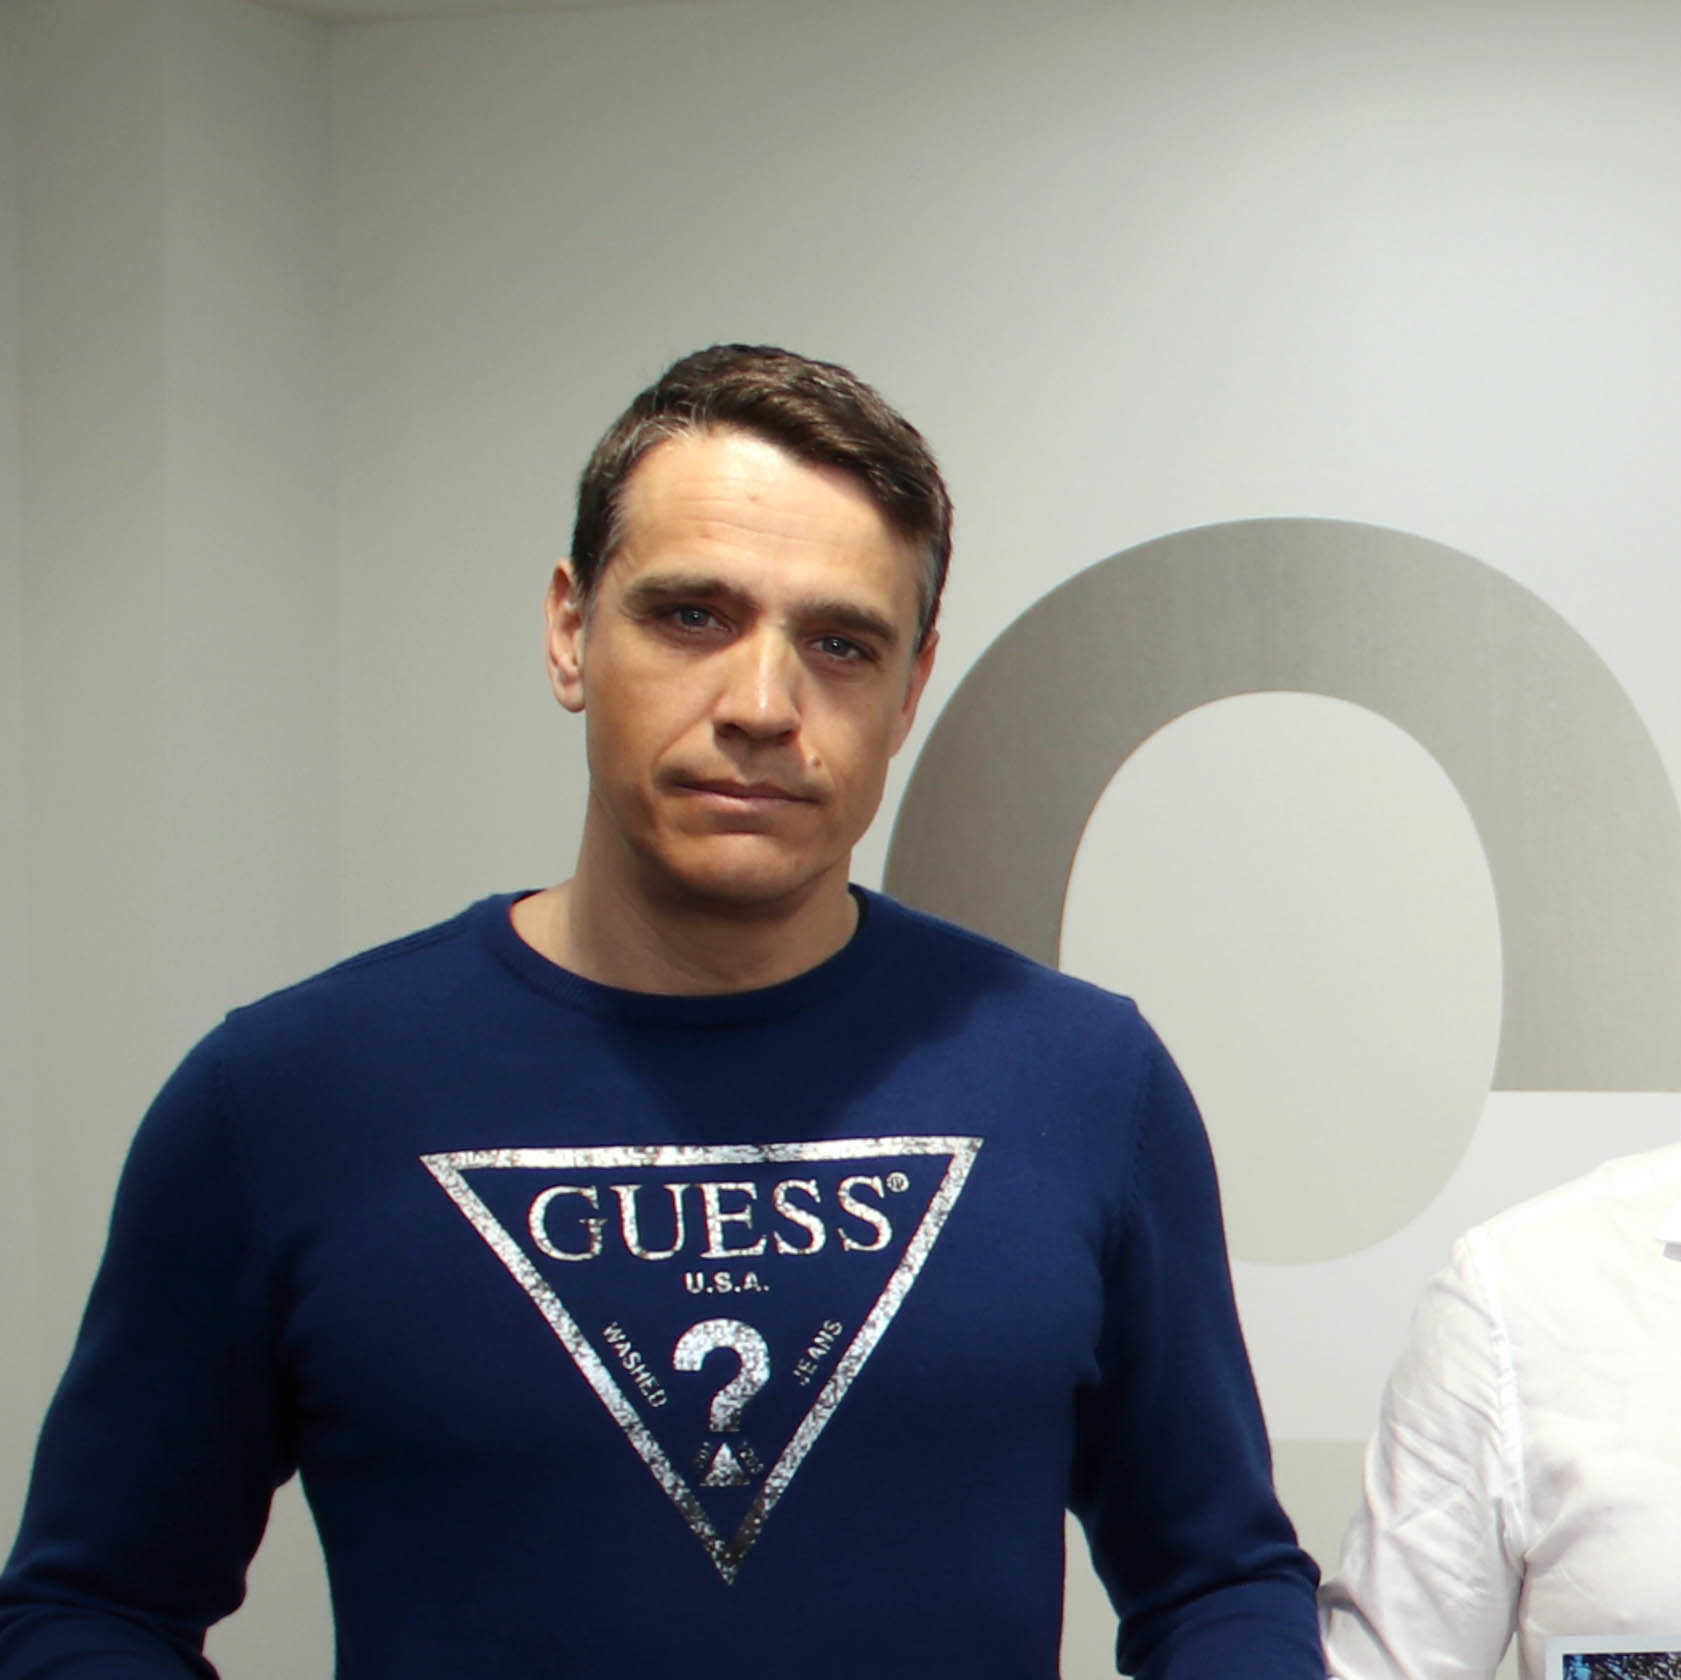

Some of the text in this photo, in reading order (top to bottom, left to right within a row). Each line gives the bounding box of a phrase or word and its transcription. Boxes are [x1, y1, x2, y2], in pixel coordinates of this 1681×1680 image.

[685, 1271, 770, 1294] U.S.A.
[602, 1321, 668, 1408] WASHED
[791, 1319, 843, 1387] JEANS
